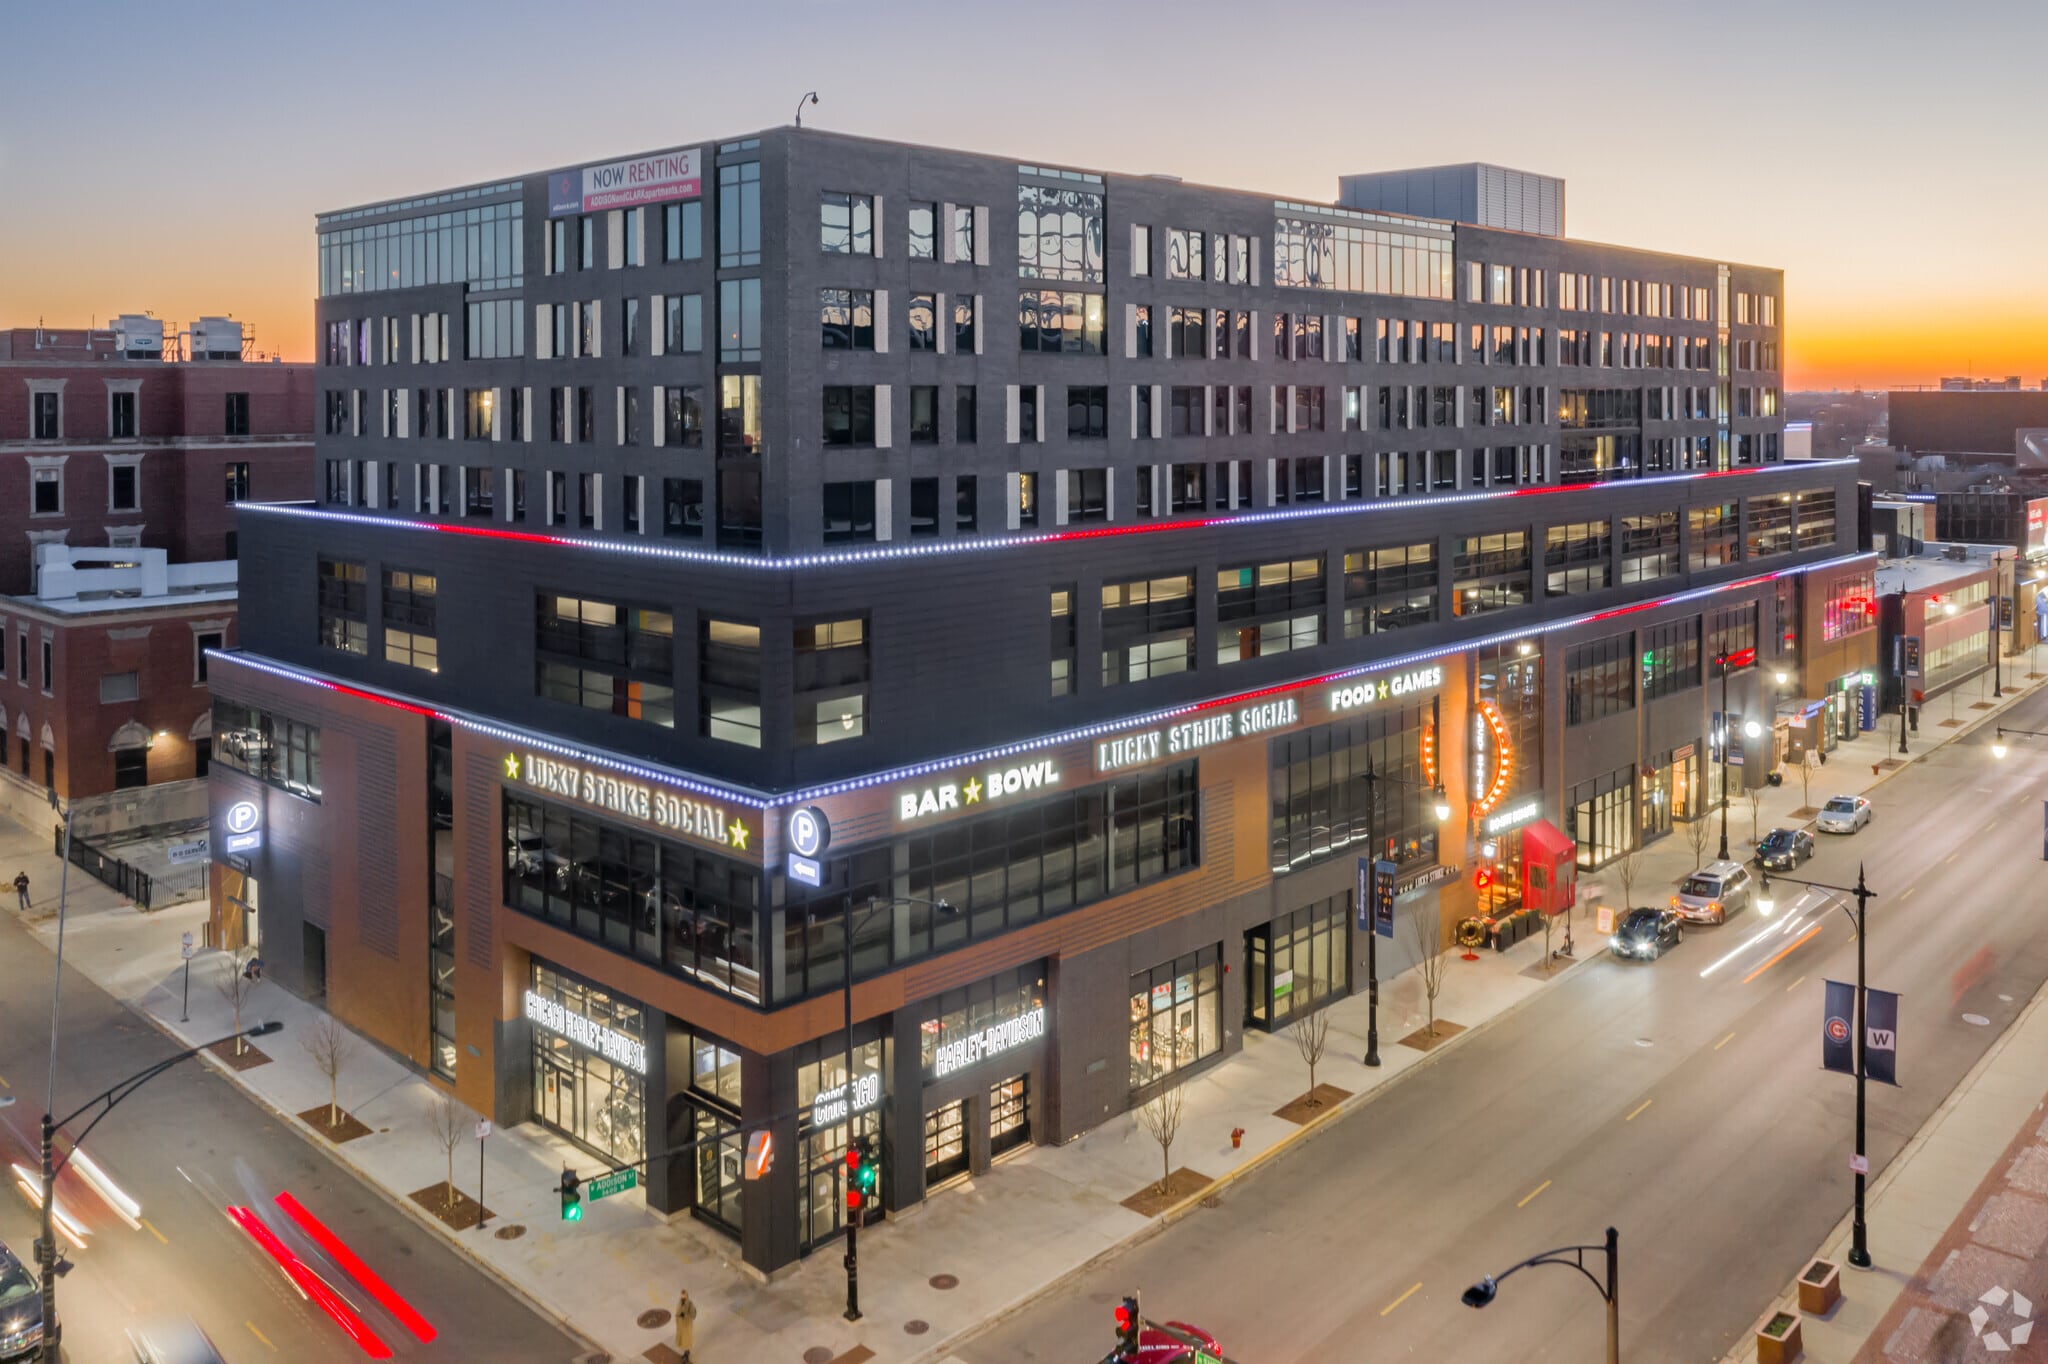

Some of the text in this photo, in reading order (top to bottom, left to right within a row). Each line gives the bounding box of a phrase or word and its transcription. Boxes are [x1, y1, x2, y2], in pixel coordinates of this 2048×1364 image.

[593, 155, 689, 190] NOW RENTING
[1331, 668, 1441, 711] FOOD GAMES
[1099, 699, 1299, 771] LUCKY STRIKE SOCIAL
[524, 754, 729, 846] LUCKY STRIKE SOCIAL
[901, 760, 1059, 820] BAR BOWL
[235, 806, 252, 829] P
[797, 816, 813, 846] P
[525, 990, 565, 1034] CHICAGO
[935, 1007, 1045, 1077] HARLEY-DAVIDSON
[1873, 1032, 1889, 1045] W
[597, 1174, 627, 1192] ADDISON
